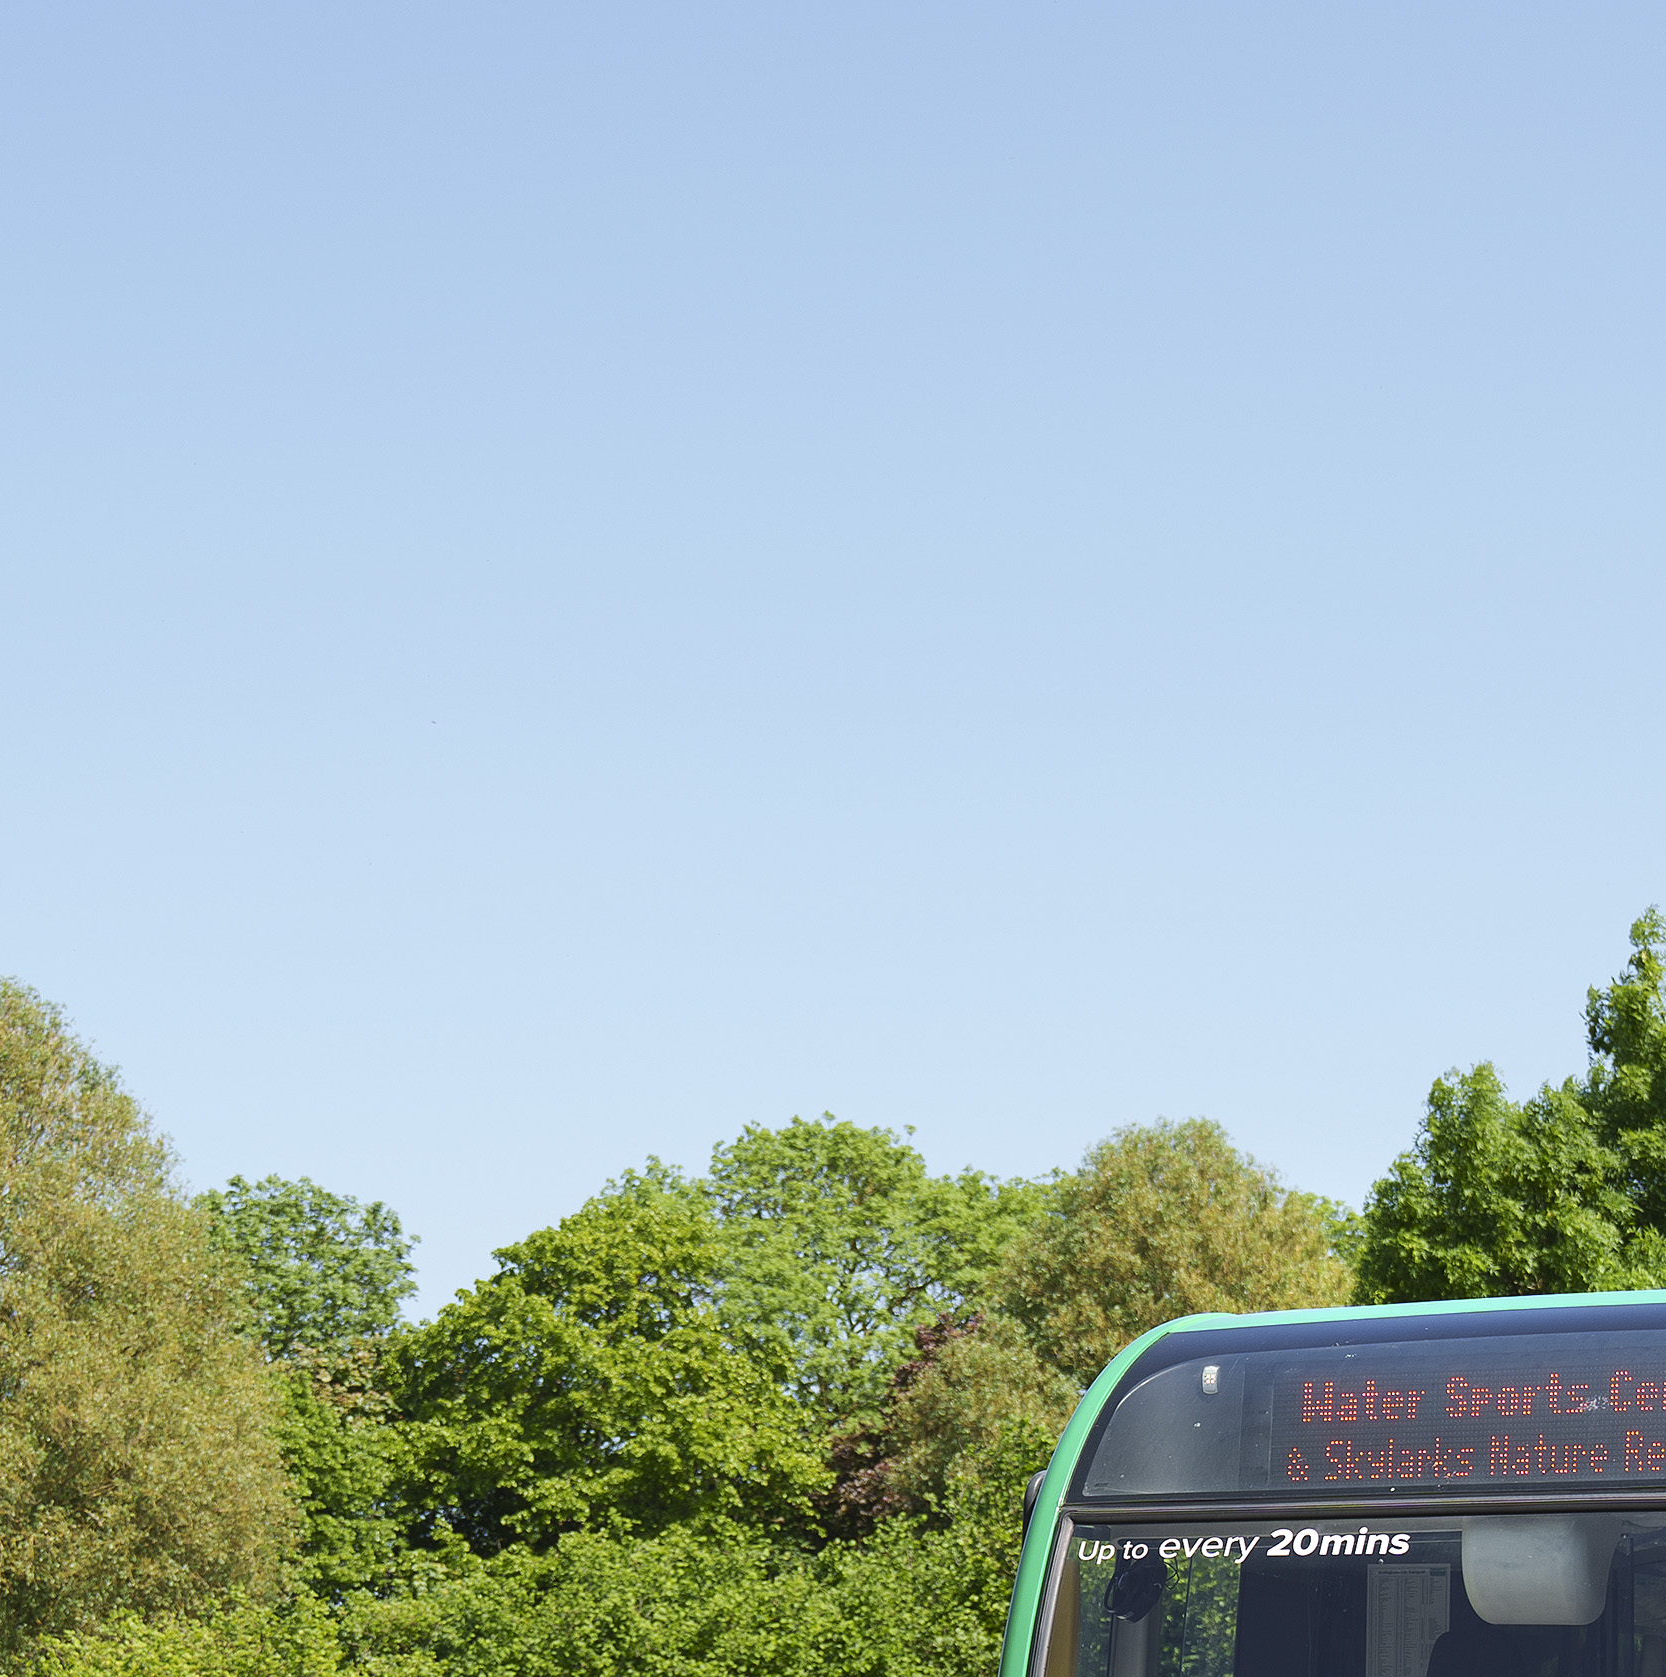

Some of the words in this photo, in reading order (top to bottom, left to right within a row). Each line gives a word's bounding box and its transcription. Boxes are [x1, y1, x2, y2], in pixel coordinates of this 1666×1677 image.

[1302, 1380, 1426, 1422] Water
[1445, 1372, 1589, 1418] Sports
[1287, 1447, 1310, 1481] &
[1323, 1438, 1475, 1481] Skylarks
[1489, 1433, 1608, 1476] Nature
[1078, 1540, 1116, 1564] Up
[1122, 1541, 1149, 1560] to
[1158, 1535, 1261, 1564] every
